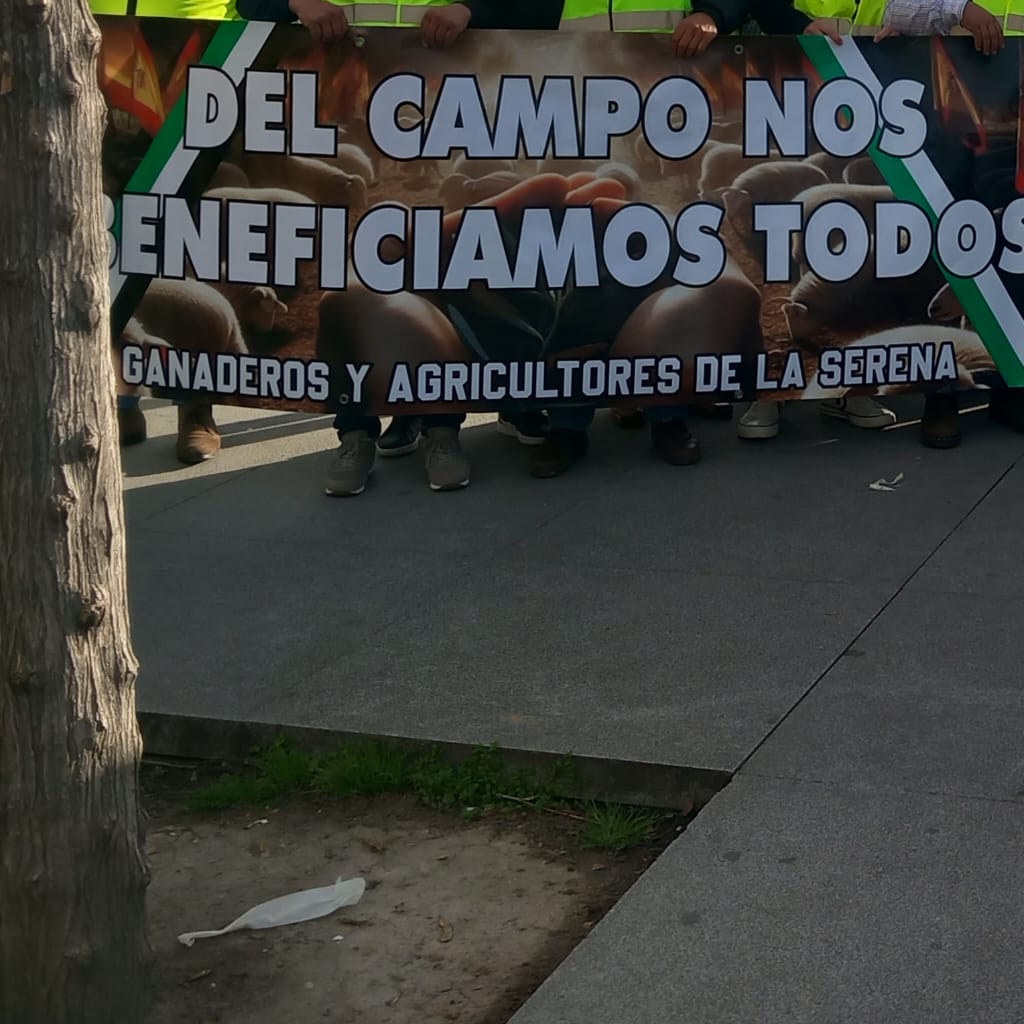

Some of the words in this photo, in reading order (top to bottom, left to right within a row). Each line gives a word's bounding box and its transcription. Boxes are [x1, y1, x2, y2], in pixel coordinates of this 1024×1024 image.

[184, 65, 338, 158] DEL
[367, 72, 712, 160] CAMPO
[744, 77, 928, 159] NOS
[120, 345, 330, 402] GANADEROS
[343, 361, 374, 404] Y
[386, 355, 681, 404] AGRICULTORES
[694, 353, 746, 396] DE
[755, 350, 805, 392] LA
[817, 340, 959, 388] SERENA
